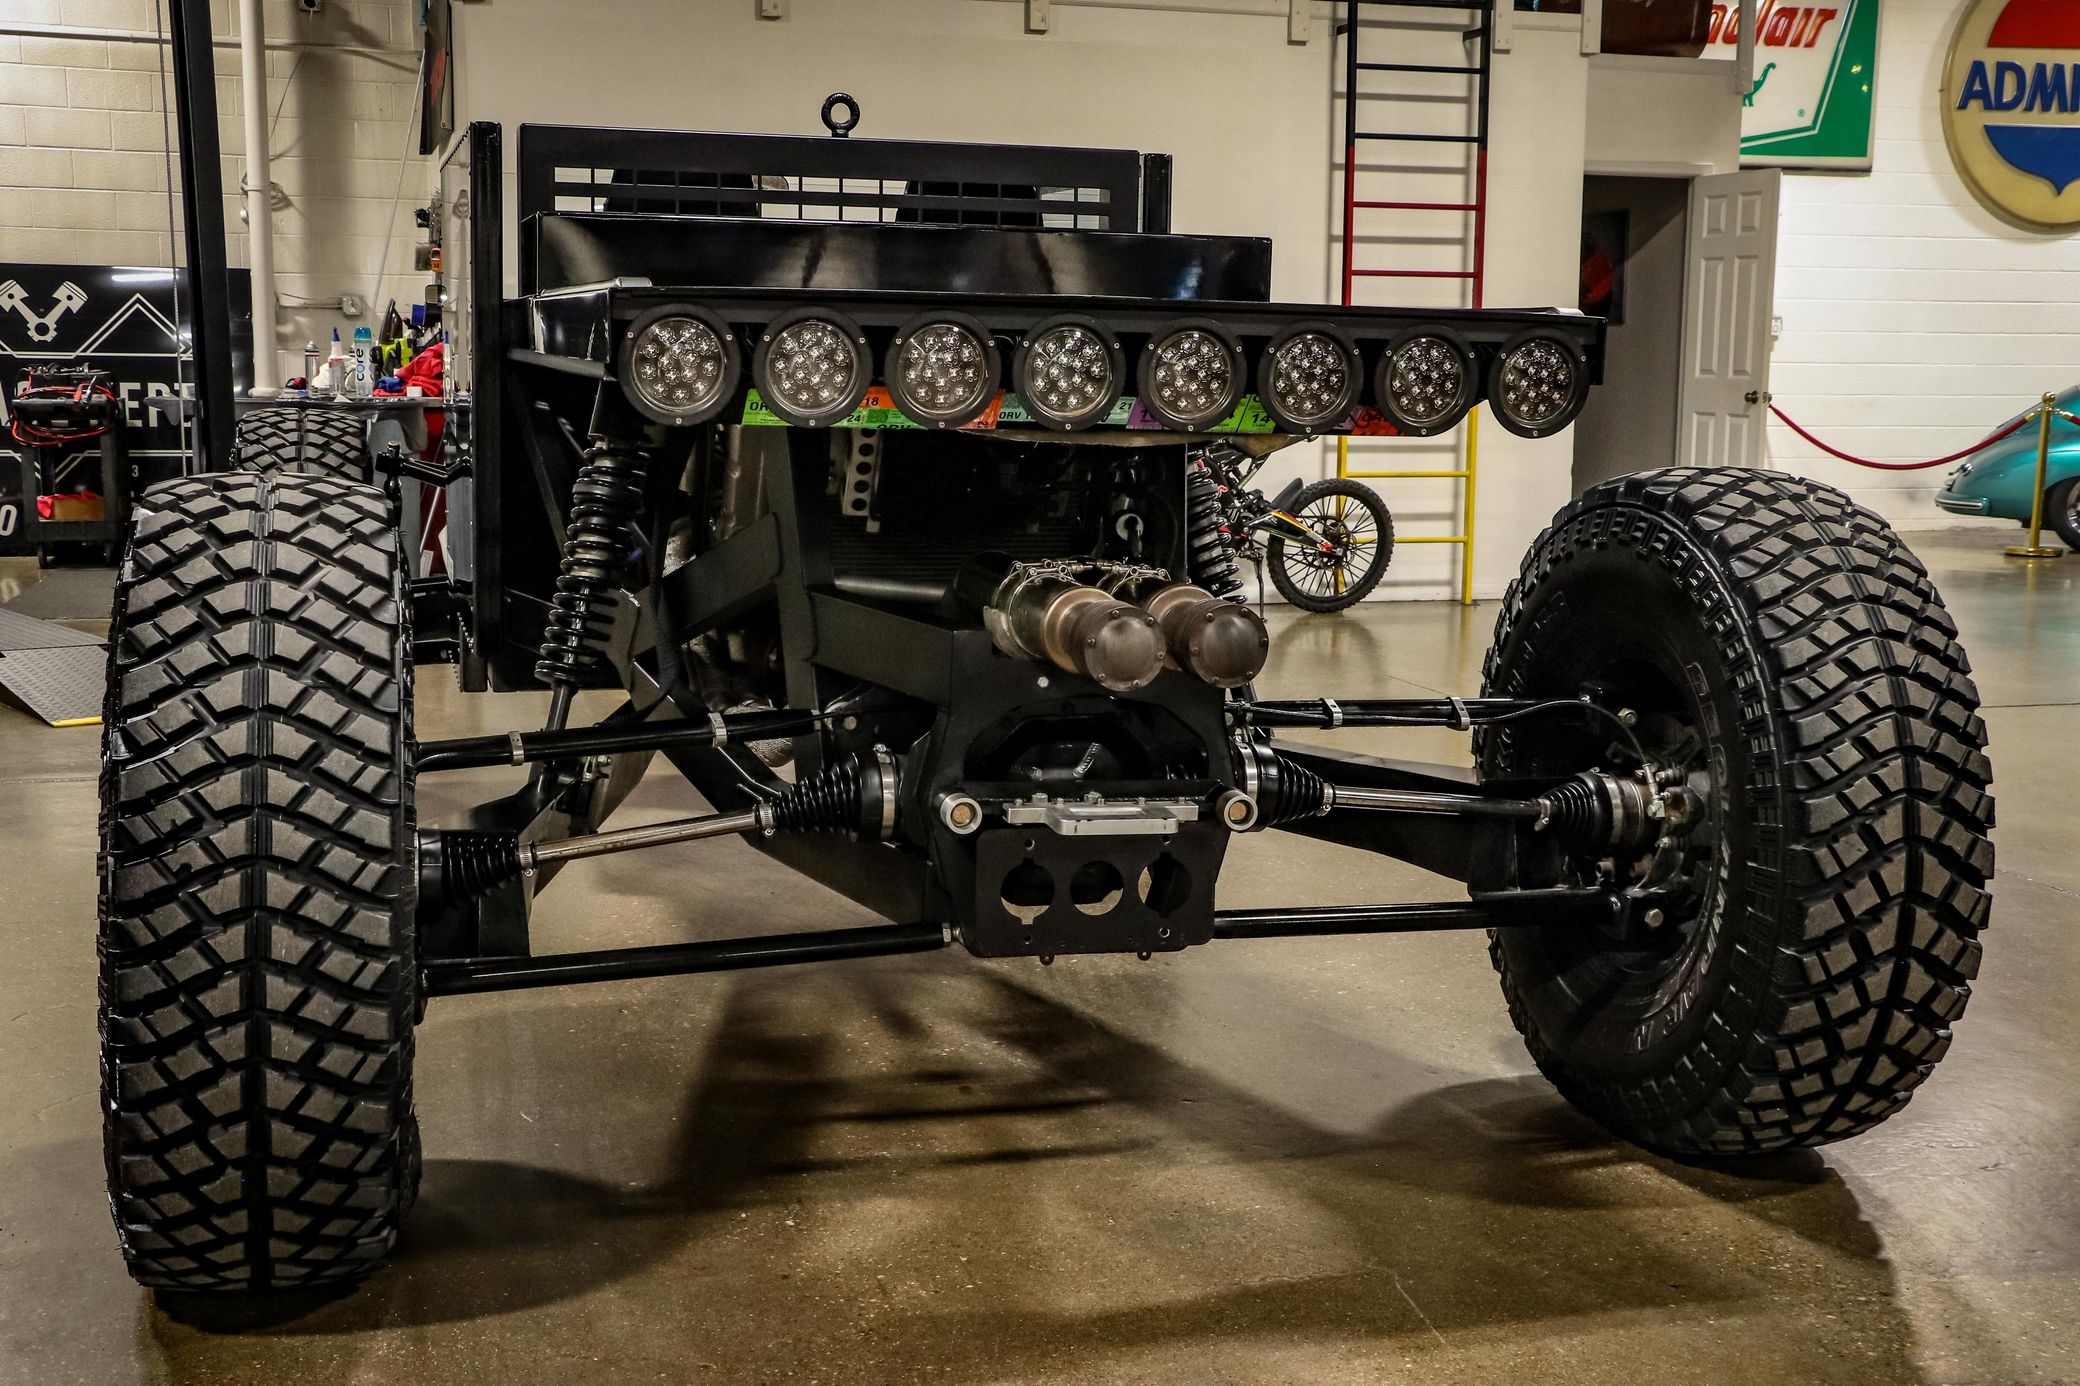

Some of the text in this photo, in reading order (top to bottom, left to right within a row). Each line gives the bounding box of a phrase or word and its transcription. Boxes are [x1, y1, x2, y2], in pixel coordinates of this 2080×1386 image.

[356, 348, 365, 381] core
[1119, 402, 1132, 410] 21
[847, 414, 860, 422] 24
[999, 411, 1022, 420] ORV
